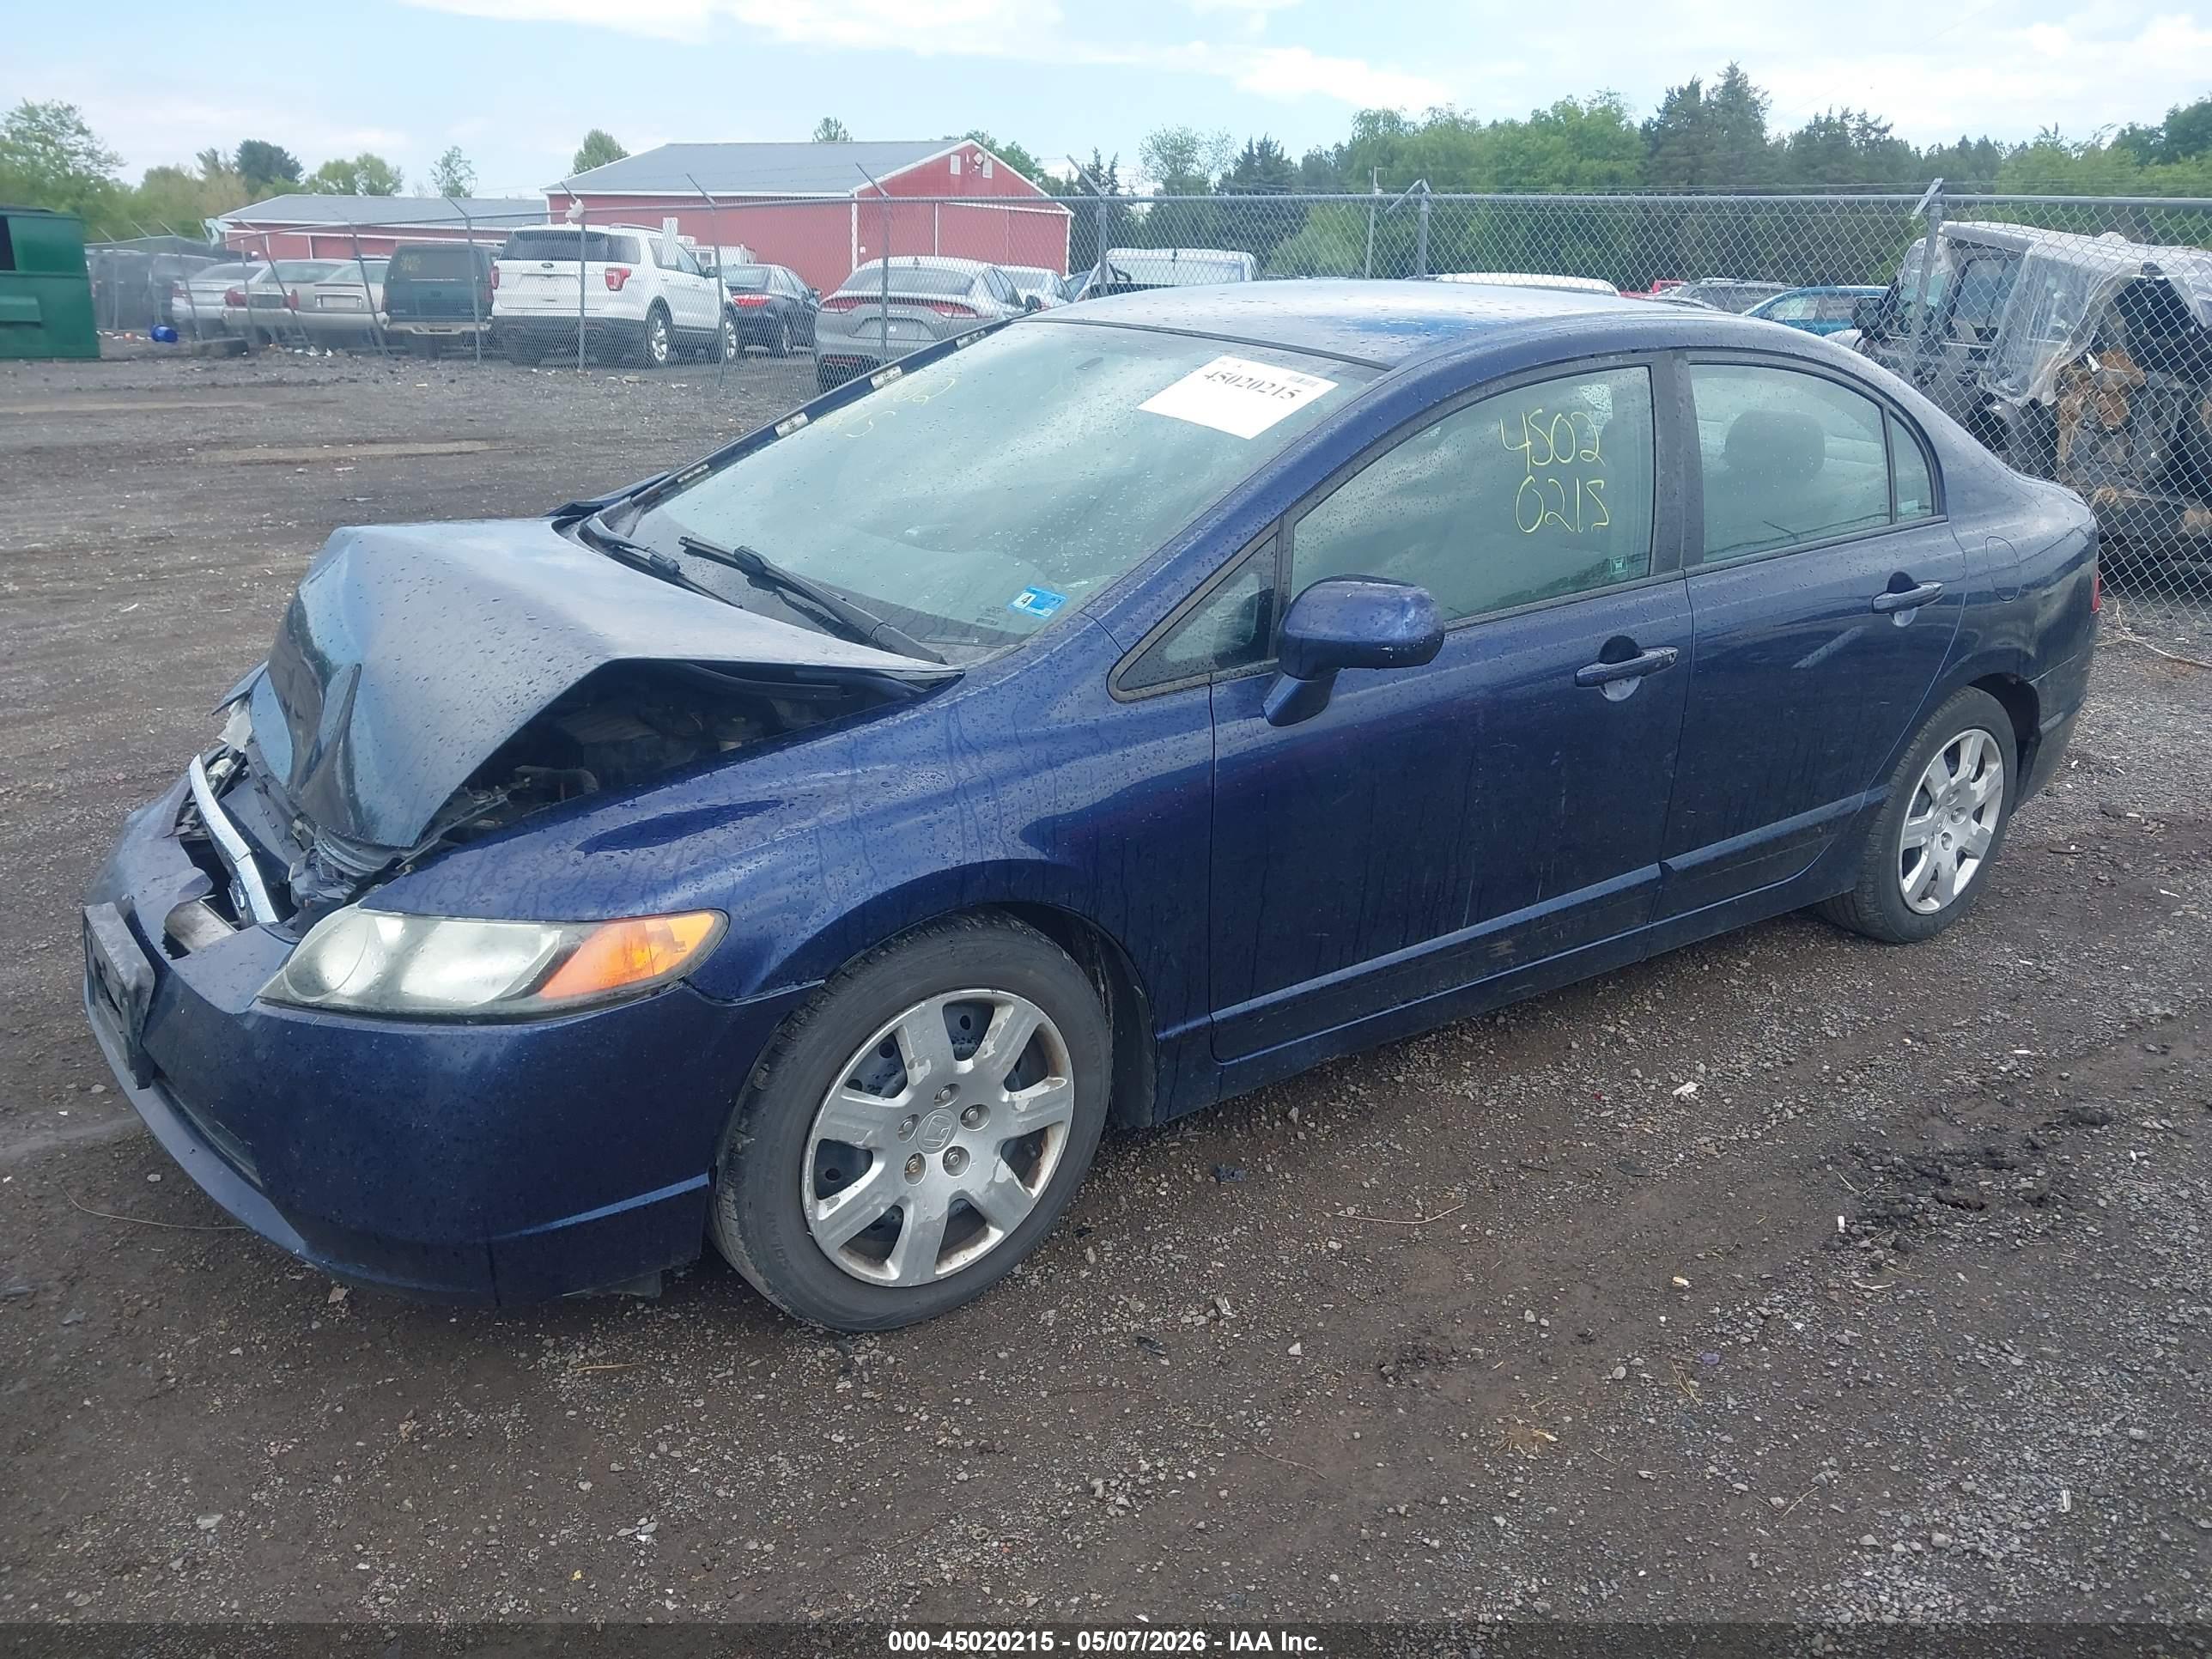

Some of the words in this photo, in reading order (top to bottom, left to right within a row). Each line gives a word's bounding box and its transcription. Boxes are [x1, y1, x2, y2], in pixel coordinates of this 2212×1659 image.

[1204, 371, 1303, 399] 45020215
[1499, 408, 1607, 473] 4502
[1516, 475, 1610, 533] 0215
